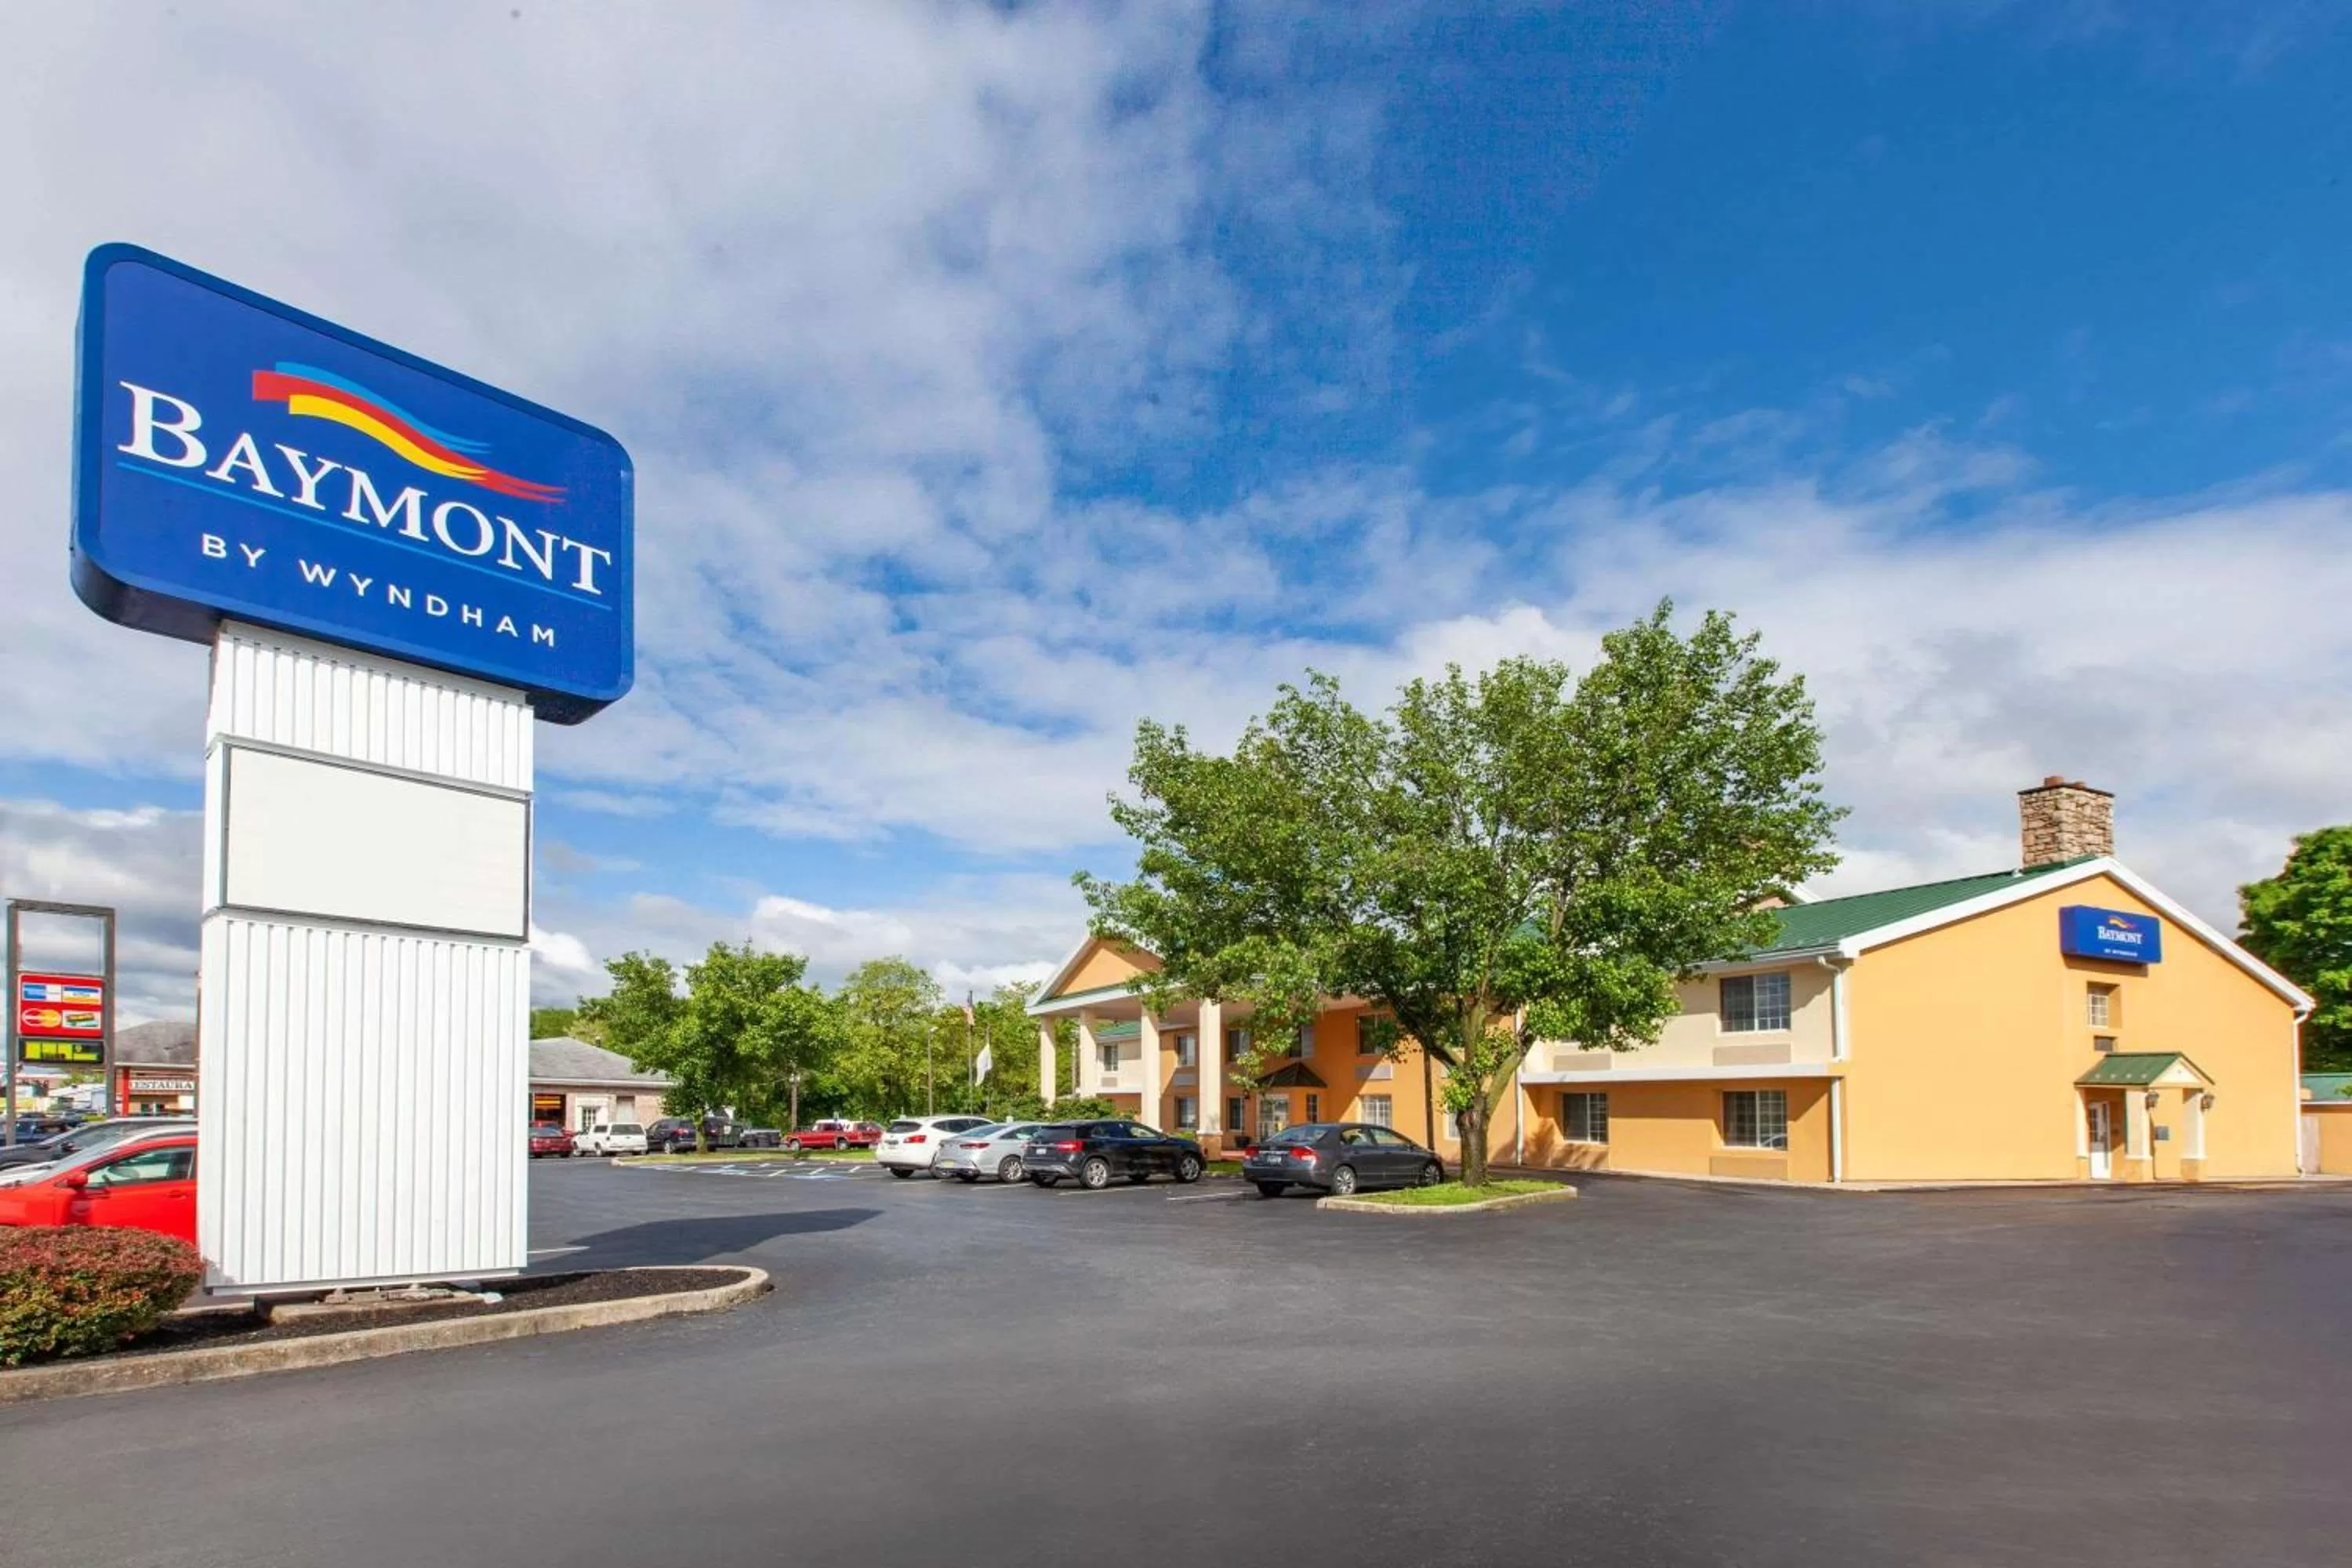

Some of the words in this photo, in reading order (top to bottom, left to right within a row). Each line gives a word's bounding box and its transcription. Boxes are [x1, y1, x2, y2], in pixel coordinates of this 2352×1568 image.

[118, 380, 611, 594] BAYMONT
[202, 533, 266, 567] BY
[299, 559, 554, 647] WYNDHAM
[2096, 926, 2143, 944] BAYMONT
